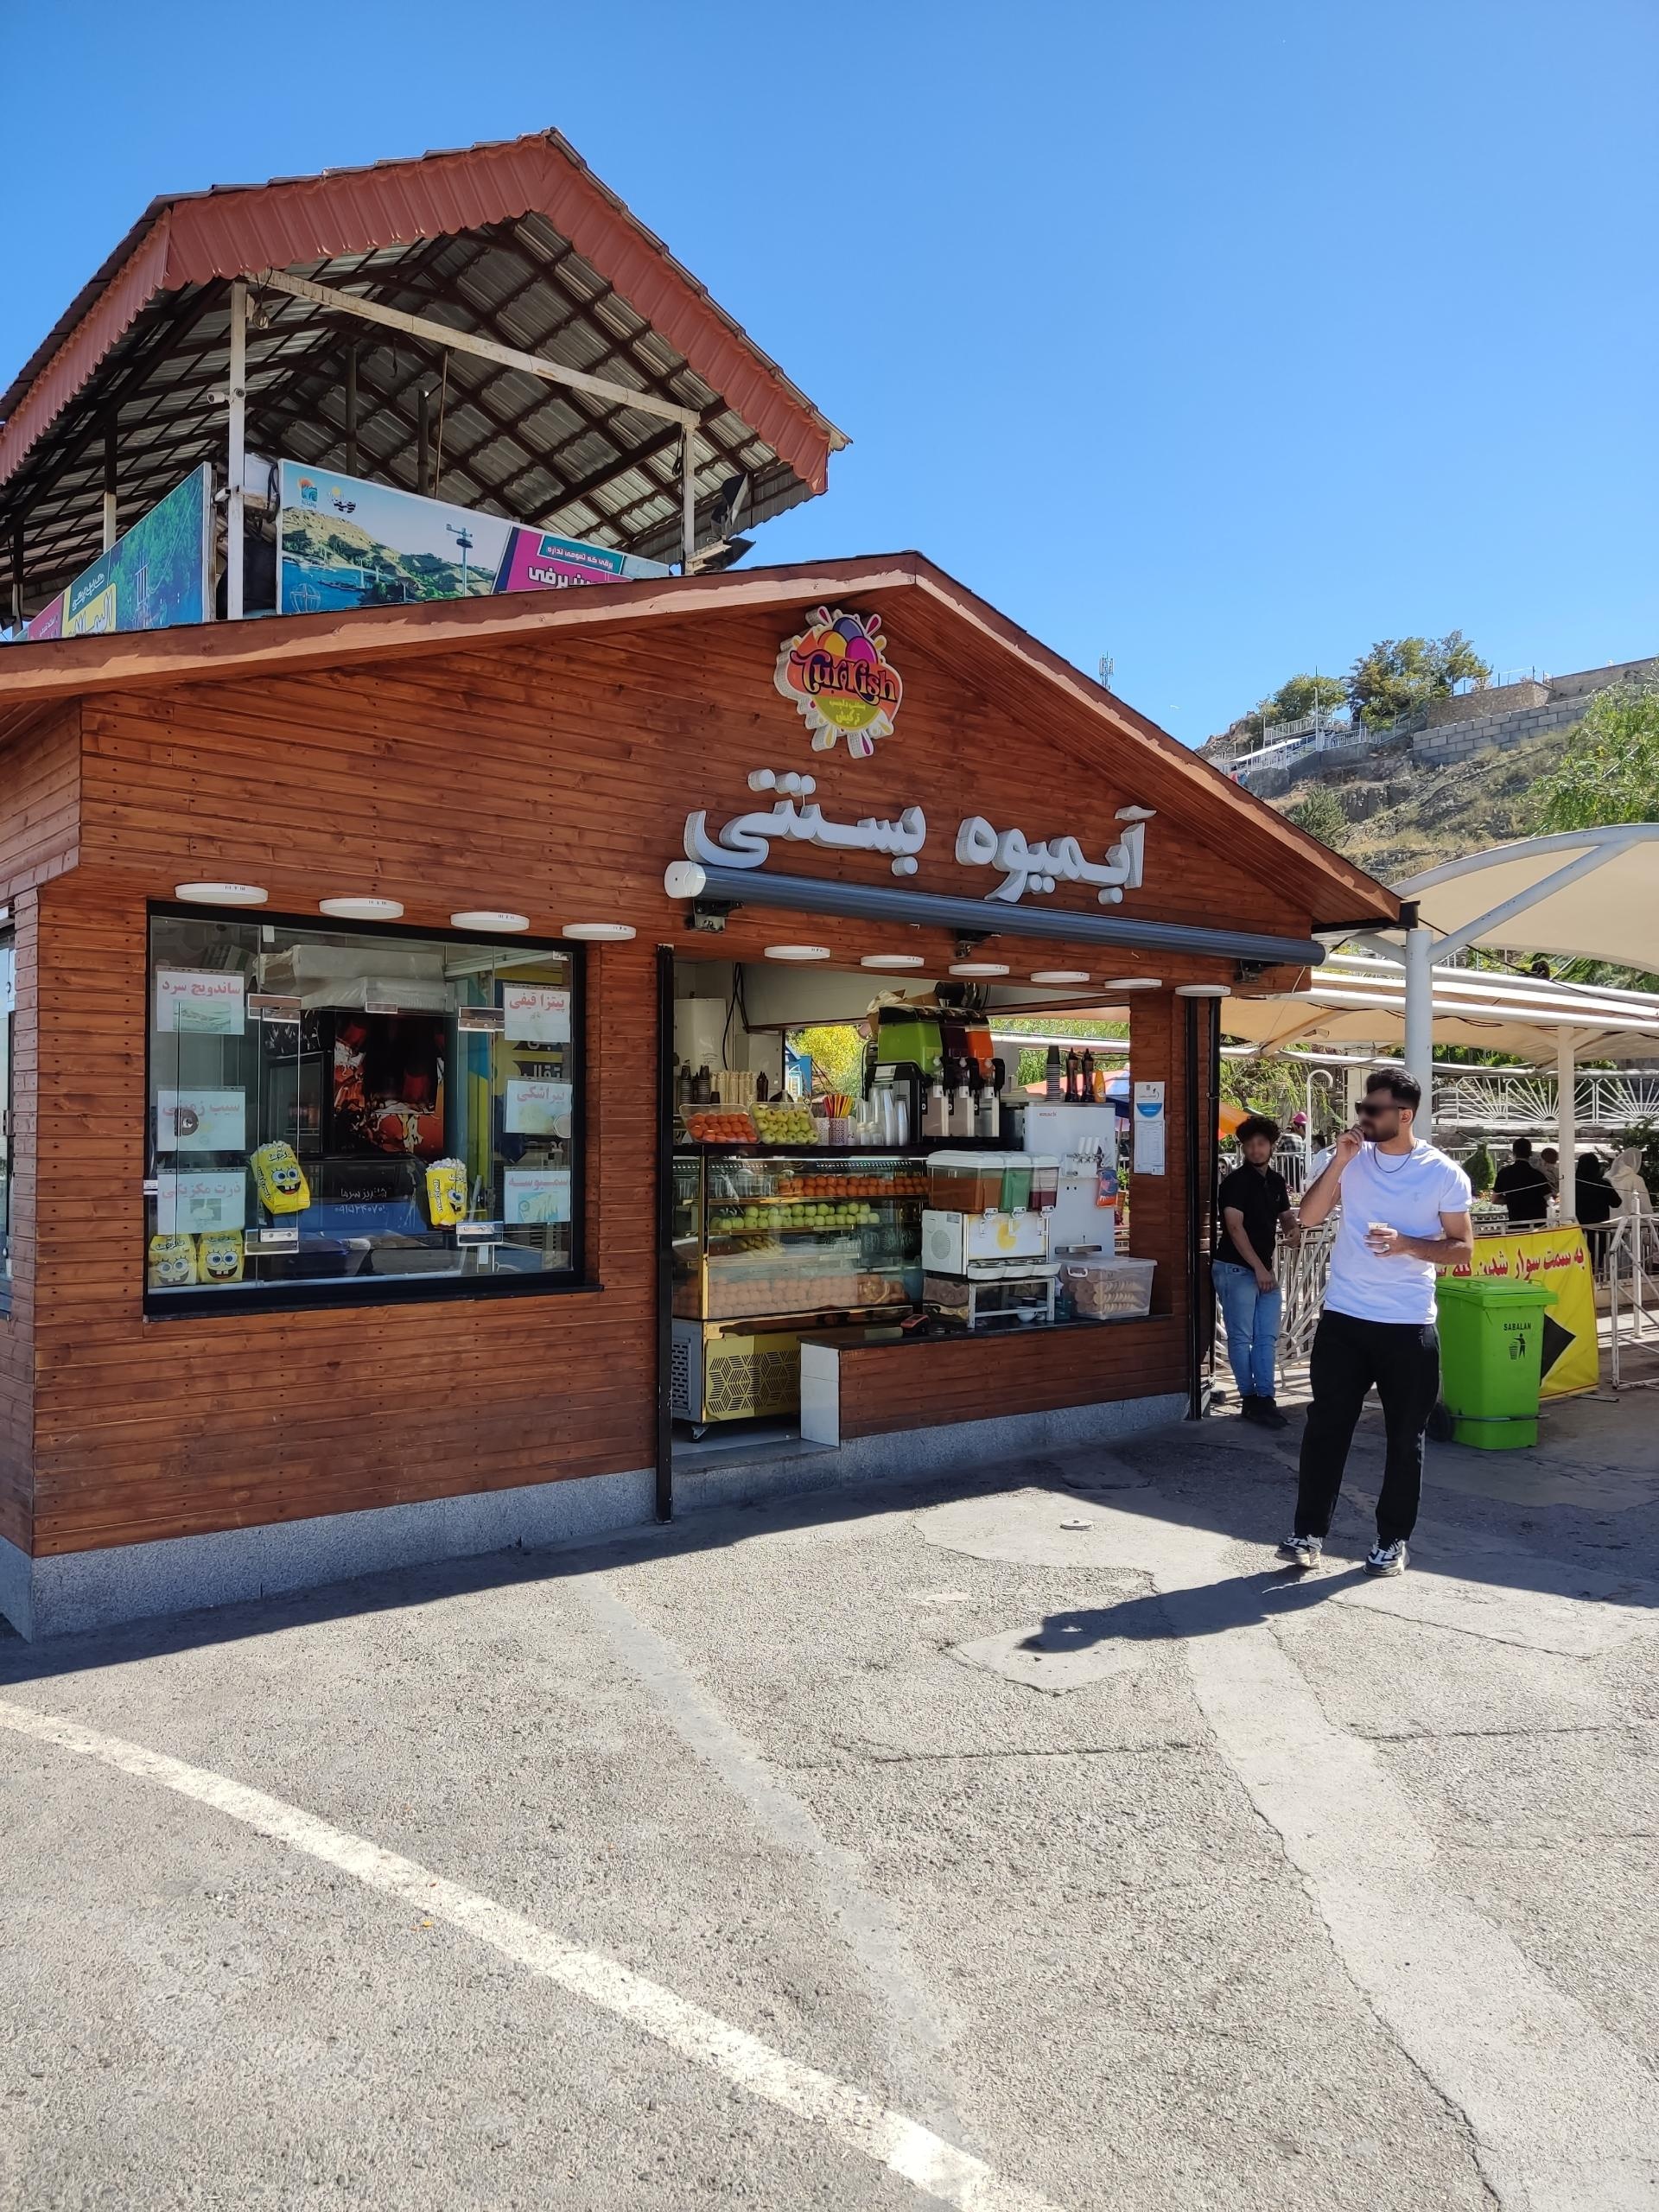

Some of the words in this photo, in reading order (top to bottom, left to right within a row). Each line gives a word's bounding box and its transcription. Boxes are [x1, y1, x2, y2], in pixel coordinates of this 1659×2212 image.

[790, 649, 898, 706] Turkish
[683, 768, 925, 877] بستنی
[956, 804, 1157, 905] آبمیوه
[162, 981, 187, 995] سرد
[191, 982, 240, 996] ساندویچ
[510, 992, 537, 1010] قیفی
[517, 1085, 565, 1103] پیراشکی
[209, 1103, 240, 1116] سیب
[214, 1181, 242, 1198] ذرت
[508, 1177, 569, 1191] سمبوسه
[1515, 1248, 1541, 1281] سوار
[1543, 1250, 1572, 1271] سمت
[1573, 1247, 1585, 1270] به
[1503, 1322, 1532, 1331] SABALAN
